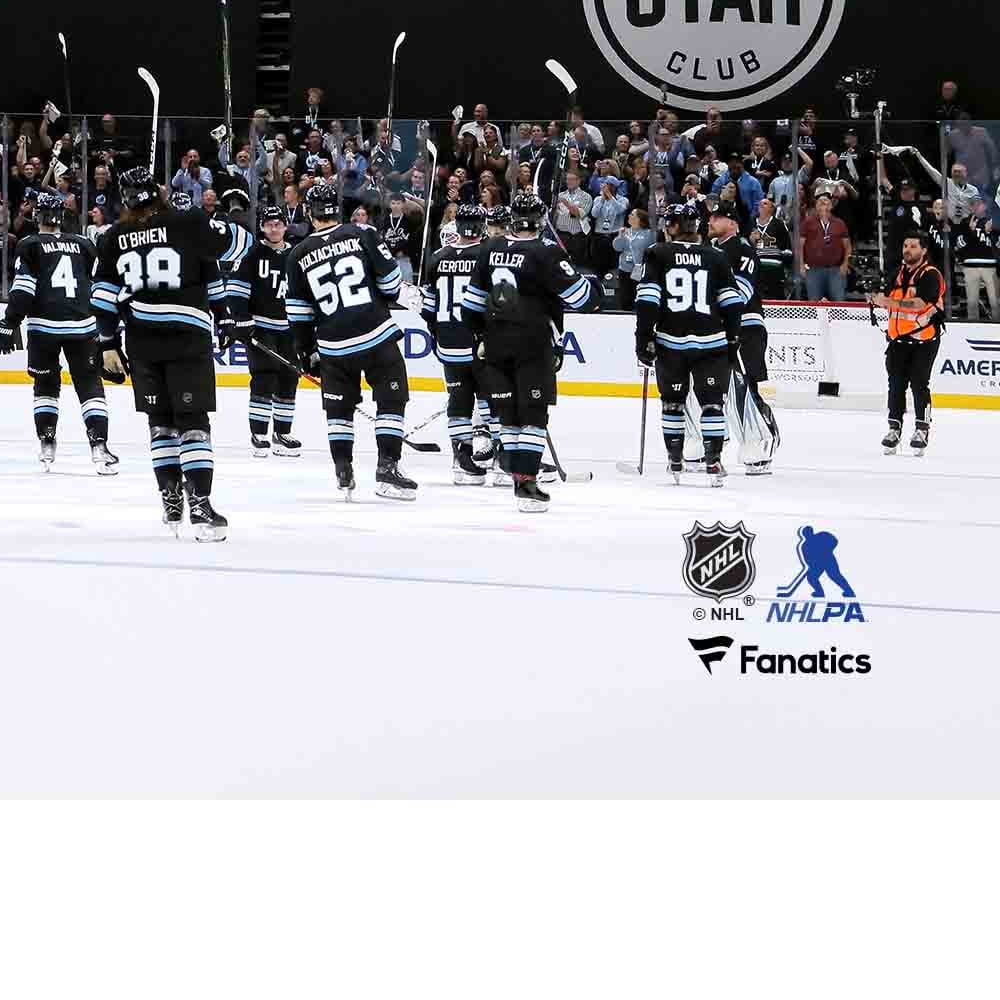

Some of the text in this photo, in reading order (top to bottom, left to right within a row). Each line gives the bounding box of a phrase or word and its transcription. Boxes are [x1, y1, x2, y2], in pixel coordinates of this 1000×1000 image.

[666, 49, 761, 81] CLUB
[118, 226, 167, 250] O'BRIEN
[489, 251, 524, 268] KELLER
[675, 253, 701, 267] DOAN
[740, 256, 755, 275] 70
[51, 254, 77, 298] 4
[306, 255, 372, 316] 52
[665, 268, 711, 315] 91
